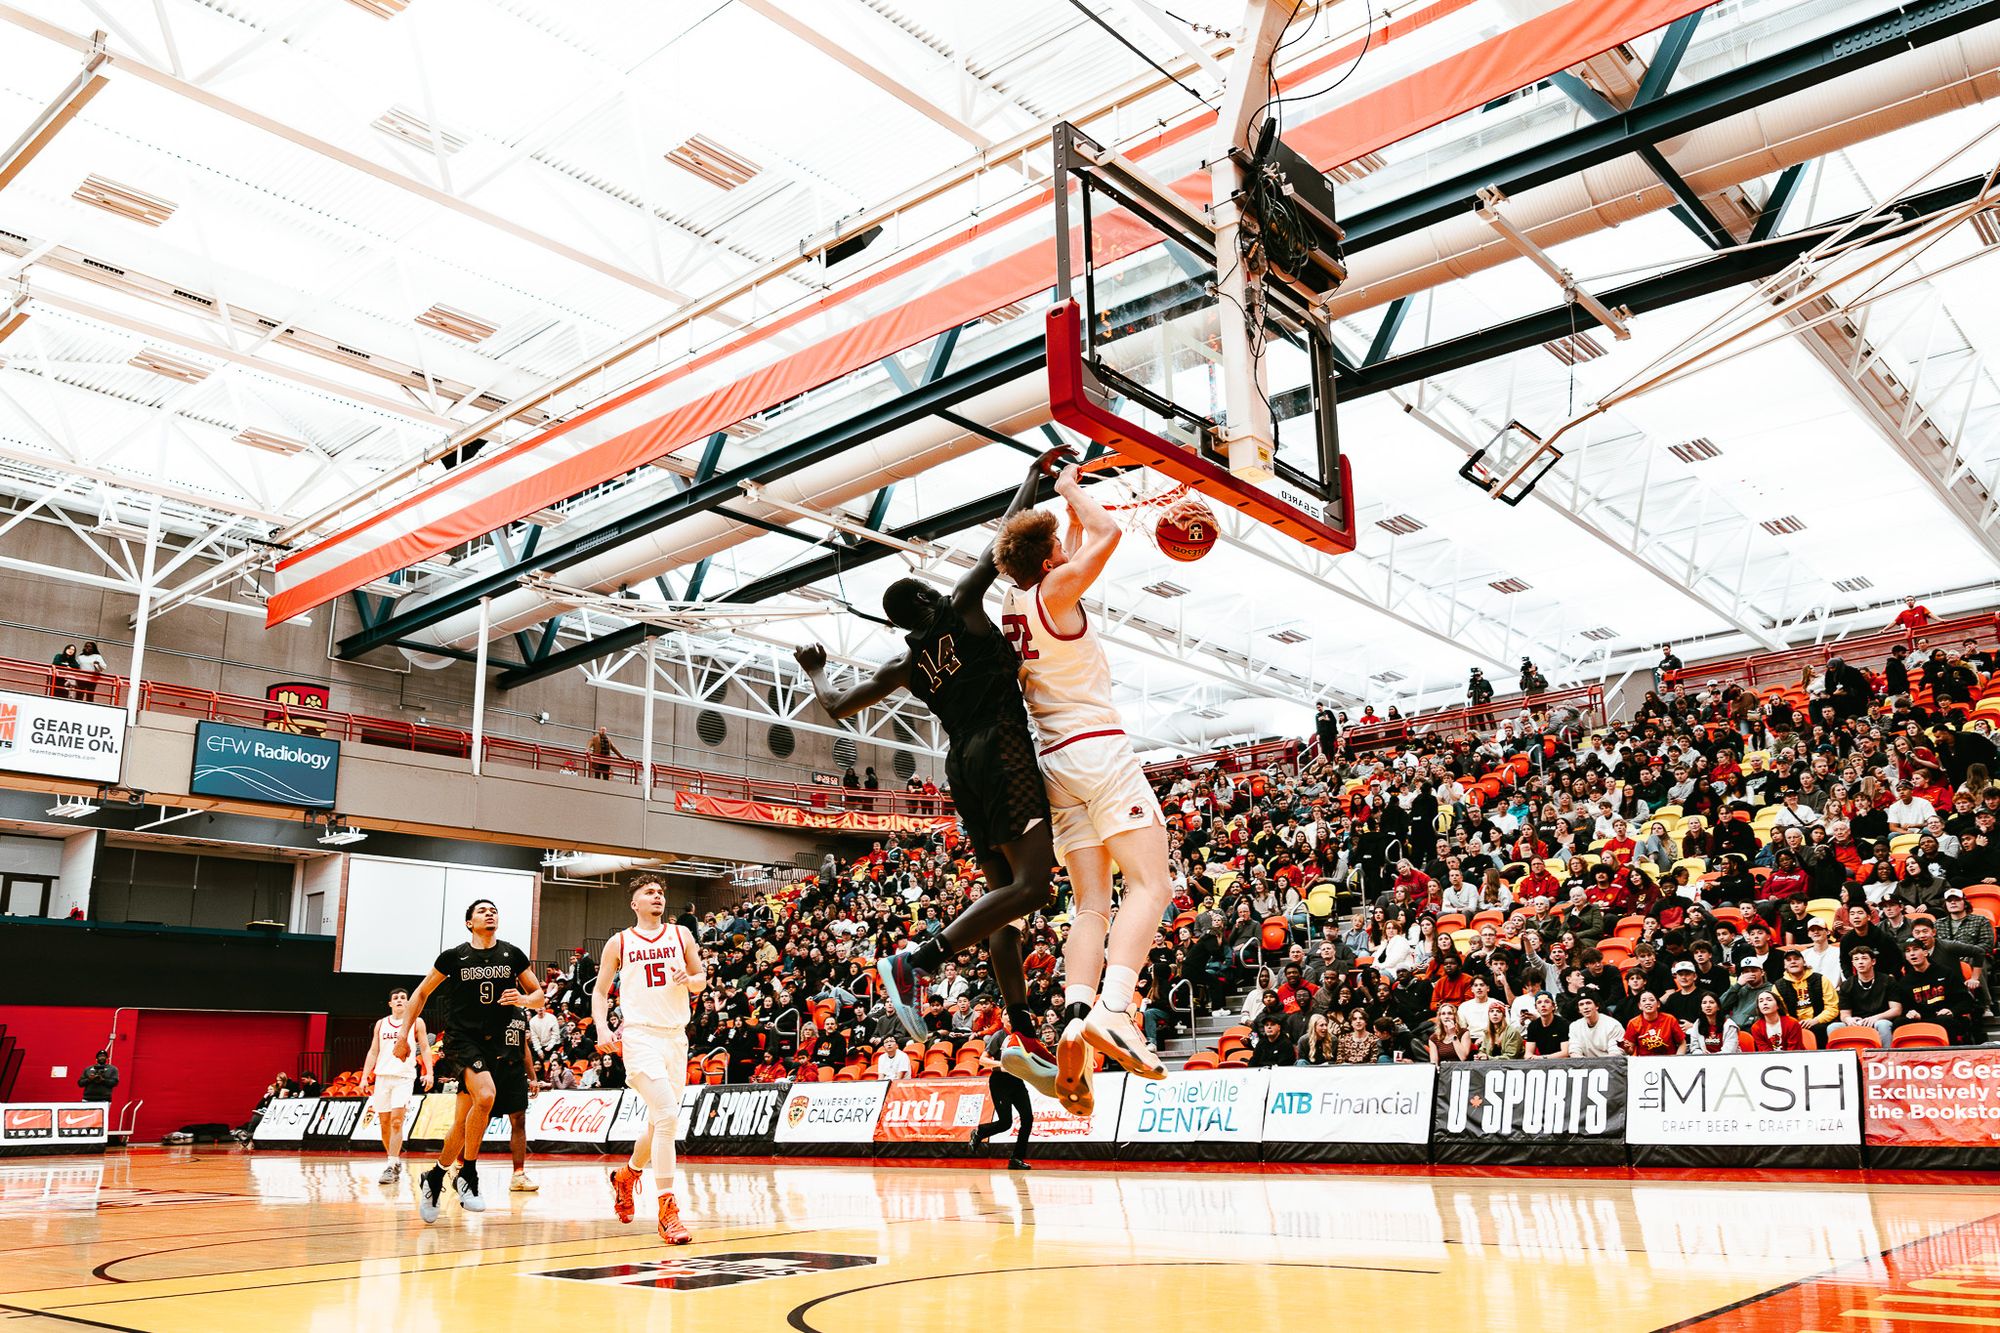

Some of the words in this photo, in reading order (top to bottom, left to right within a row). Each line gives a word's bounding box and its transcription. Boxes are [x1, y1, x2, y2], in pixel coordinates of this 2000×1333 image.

[917, 634, 962, 693] 14
[33, 717, 83, 735] GEAR
[87, 724, 113, 739] UP.
[31, 731, 85, 750] GAME
[88, 739, 118, 754] ON.
[206, 735, 251, 755] EFW
[254, 742, 331, 770] Radiology
[770, 805, 799, 824] WE
[838, 813, 875, 831] ALL
[877, 815, 933, 834] DINOS
[628, 946, 676, 963] CALGARY
[460, 965, 511, 981] BISONS
[644, 962, 667, 988] 15
[479, 981, 494, 1004] 9
[505, 1029, 519, 1046] 21
[1868, 1061, 1944, 1080] Dinos
[1638, 1071, 1659, 1110] the
[1661, 1063, 1845, 1112] MASH
[1868, 1084, 1990, 1101] Exclusively
[811, 1097, 863, 1106] UNIVERSITY
[864, 1096, 877, 1106] OF
[885, 1092, 945, 1121] arch
[1271, 1092, 1313, 1114] ATB
[1319, 1091, 1420, 1115] Financial
[1446, 1069, 1471, 1134] U
[1481, 1068, 1609, 1135] SPORTS
[1868, 1103, 1904, 1119] the
[1910, 1103, 2000, 1120] Booksto
[694, 1091, 715, 1137] U
[710, 1090, 779, 1136] SPORTS
[808, 1108, 874, 1123] CALGARY
[1138, 1106, 1238, 1132] DENTAL
[1662, 1120, 1701, 1132] CRAFT
[1707, 1119, 1739, 1132] BEER
[1759, 1119, 1800, 1132] CRAFT
[1807, 1118, 1844, 1131] PIZZA
[8, 1129, 48, 1137] TEAM
